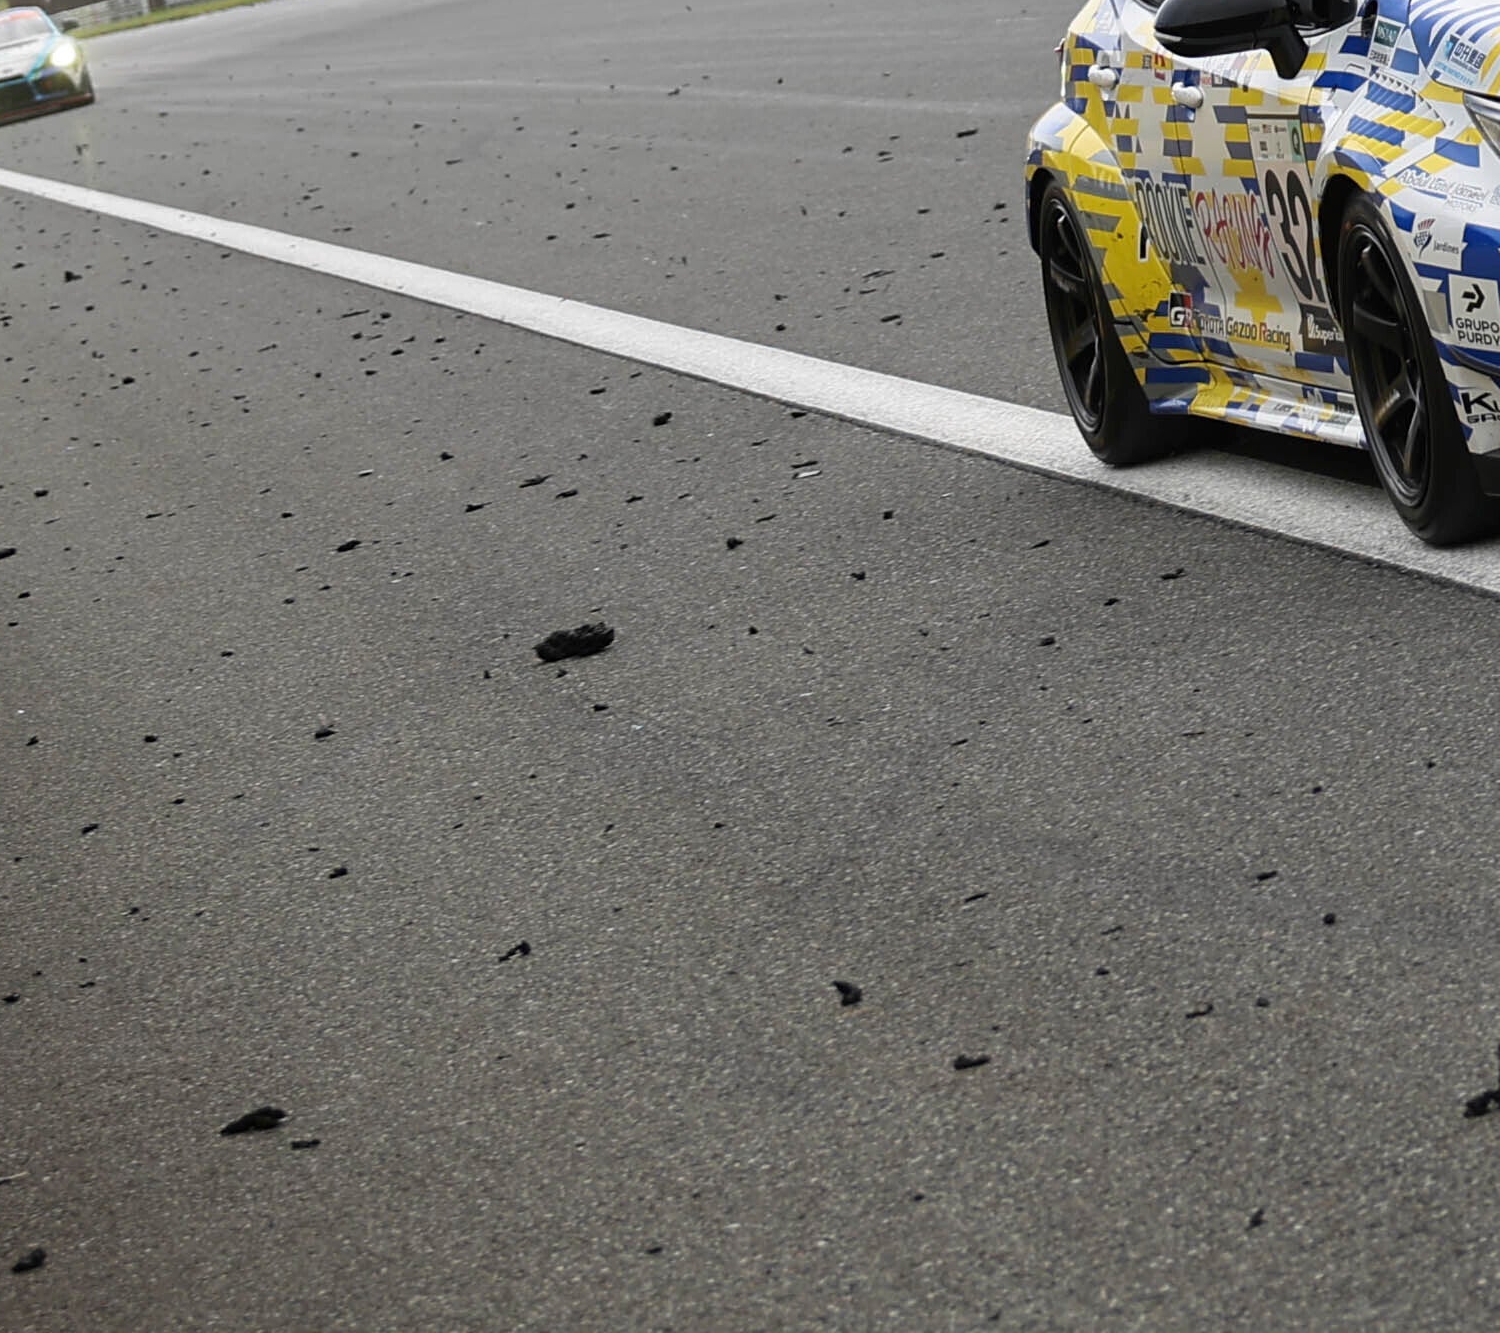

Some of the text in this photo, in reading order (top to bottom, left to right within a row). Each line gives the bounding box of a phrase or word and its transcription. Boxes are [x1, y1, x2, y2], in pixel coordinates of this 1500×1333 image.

[1133, 180, 1276, 279] ROOKIE RACING
[1264, 169, 1327, 304] 32
[1225, 316, 1257, 340] GAZOO
[1258, 321, 1291, 351] Racing
[1455, 317, 1500, 334] GRUPO
[1457, 331, 1500, 347] PURDY
